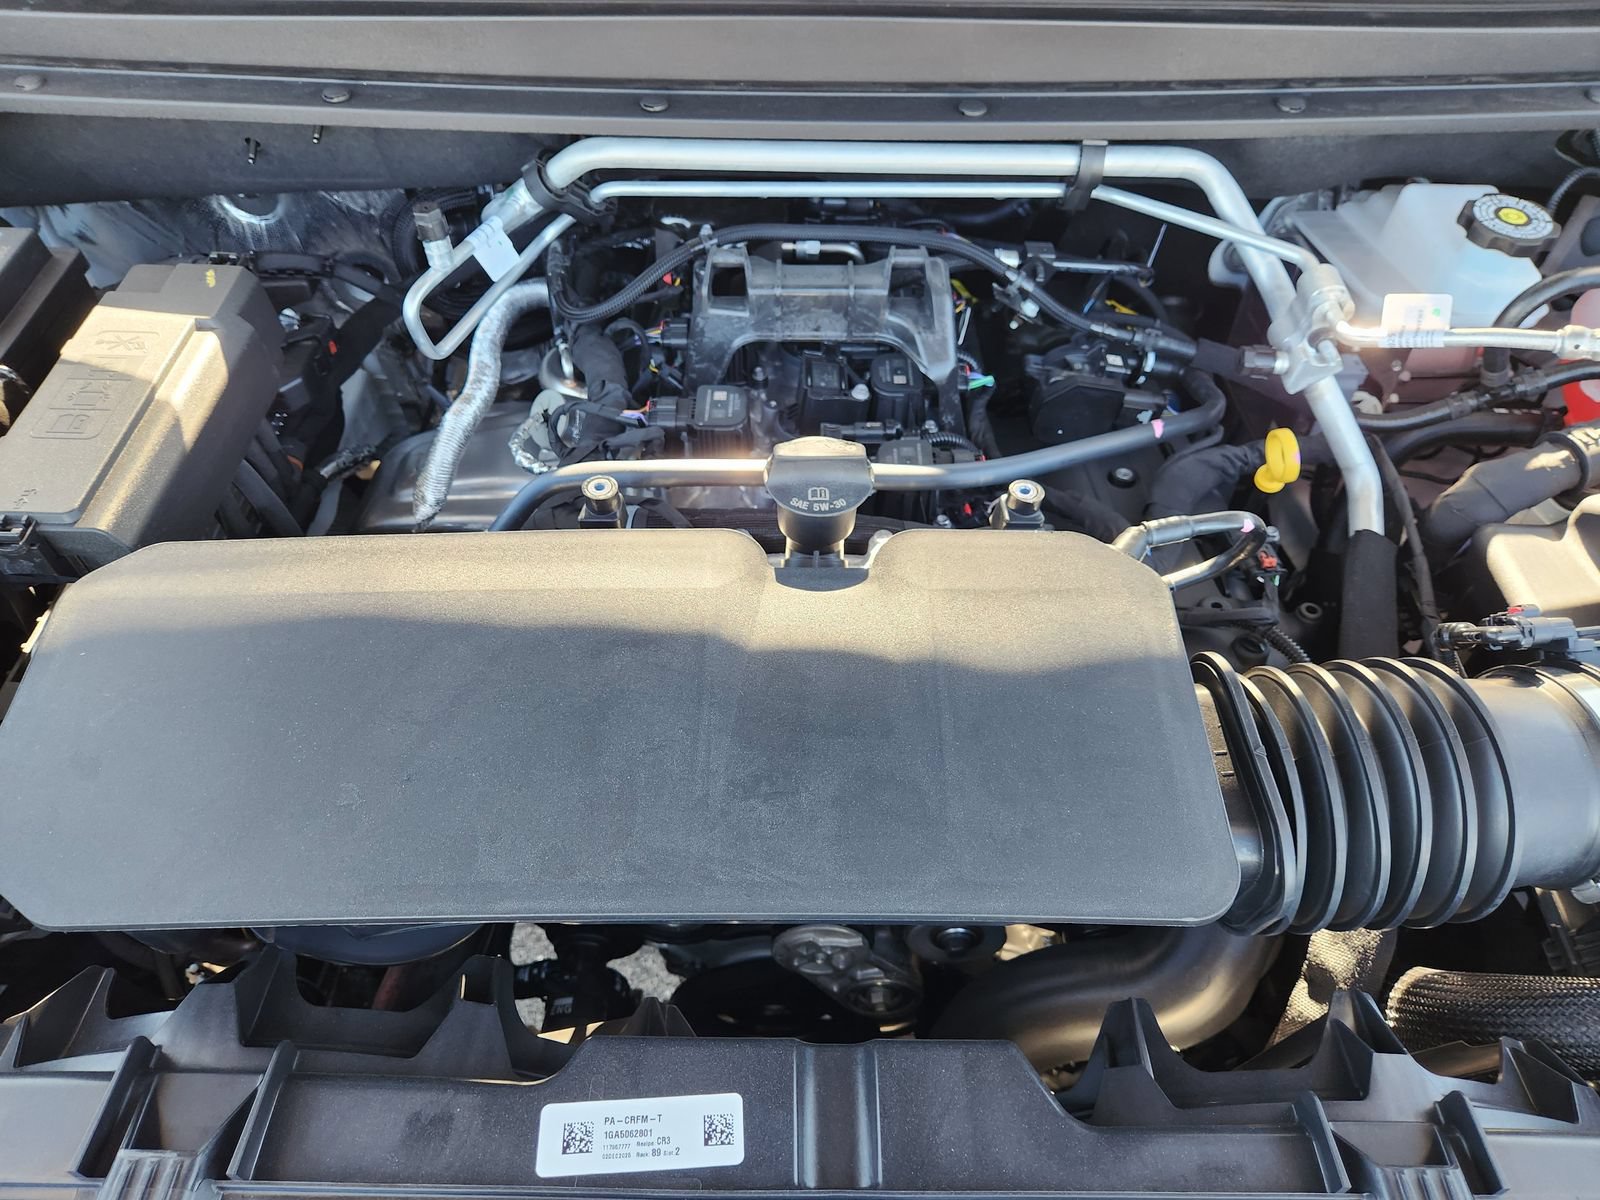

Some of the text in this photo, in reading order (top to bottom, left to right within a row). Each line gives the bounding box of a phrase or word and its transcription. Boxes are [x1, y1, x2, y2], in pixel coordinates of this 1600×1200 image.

[789, 497, 847, 511] SAE 5W-30
[656, 1136, 671, 1146] CR3
[651, 1148, 661, 1157] 89
[675, 1147, 680, 1156] 2
